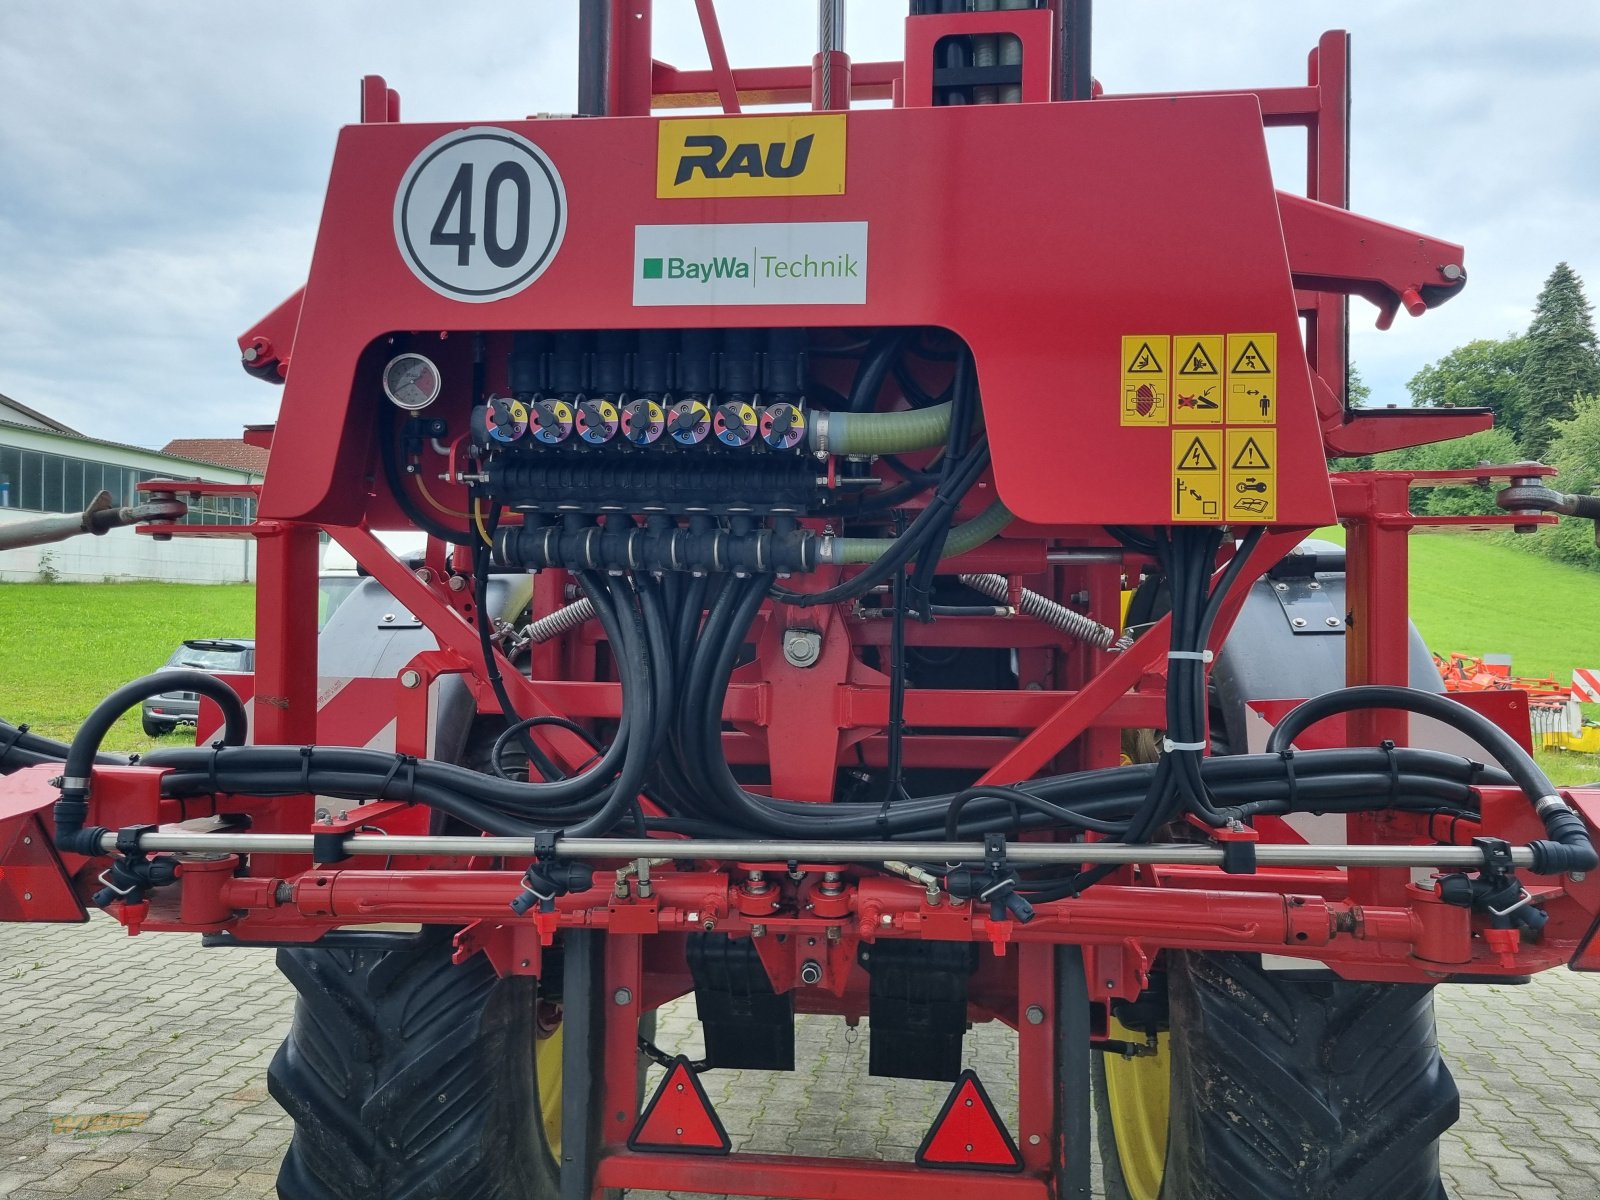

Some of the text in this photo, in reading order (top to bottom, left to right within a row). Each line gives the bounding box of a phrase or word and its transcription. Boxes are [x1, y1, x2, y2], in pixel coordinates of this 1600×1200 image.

[674, 134, 815, 187] RAU
[430, 160, 531, 268] 40
[667, 254, 858, 284] BayWa Technik
